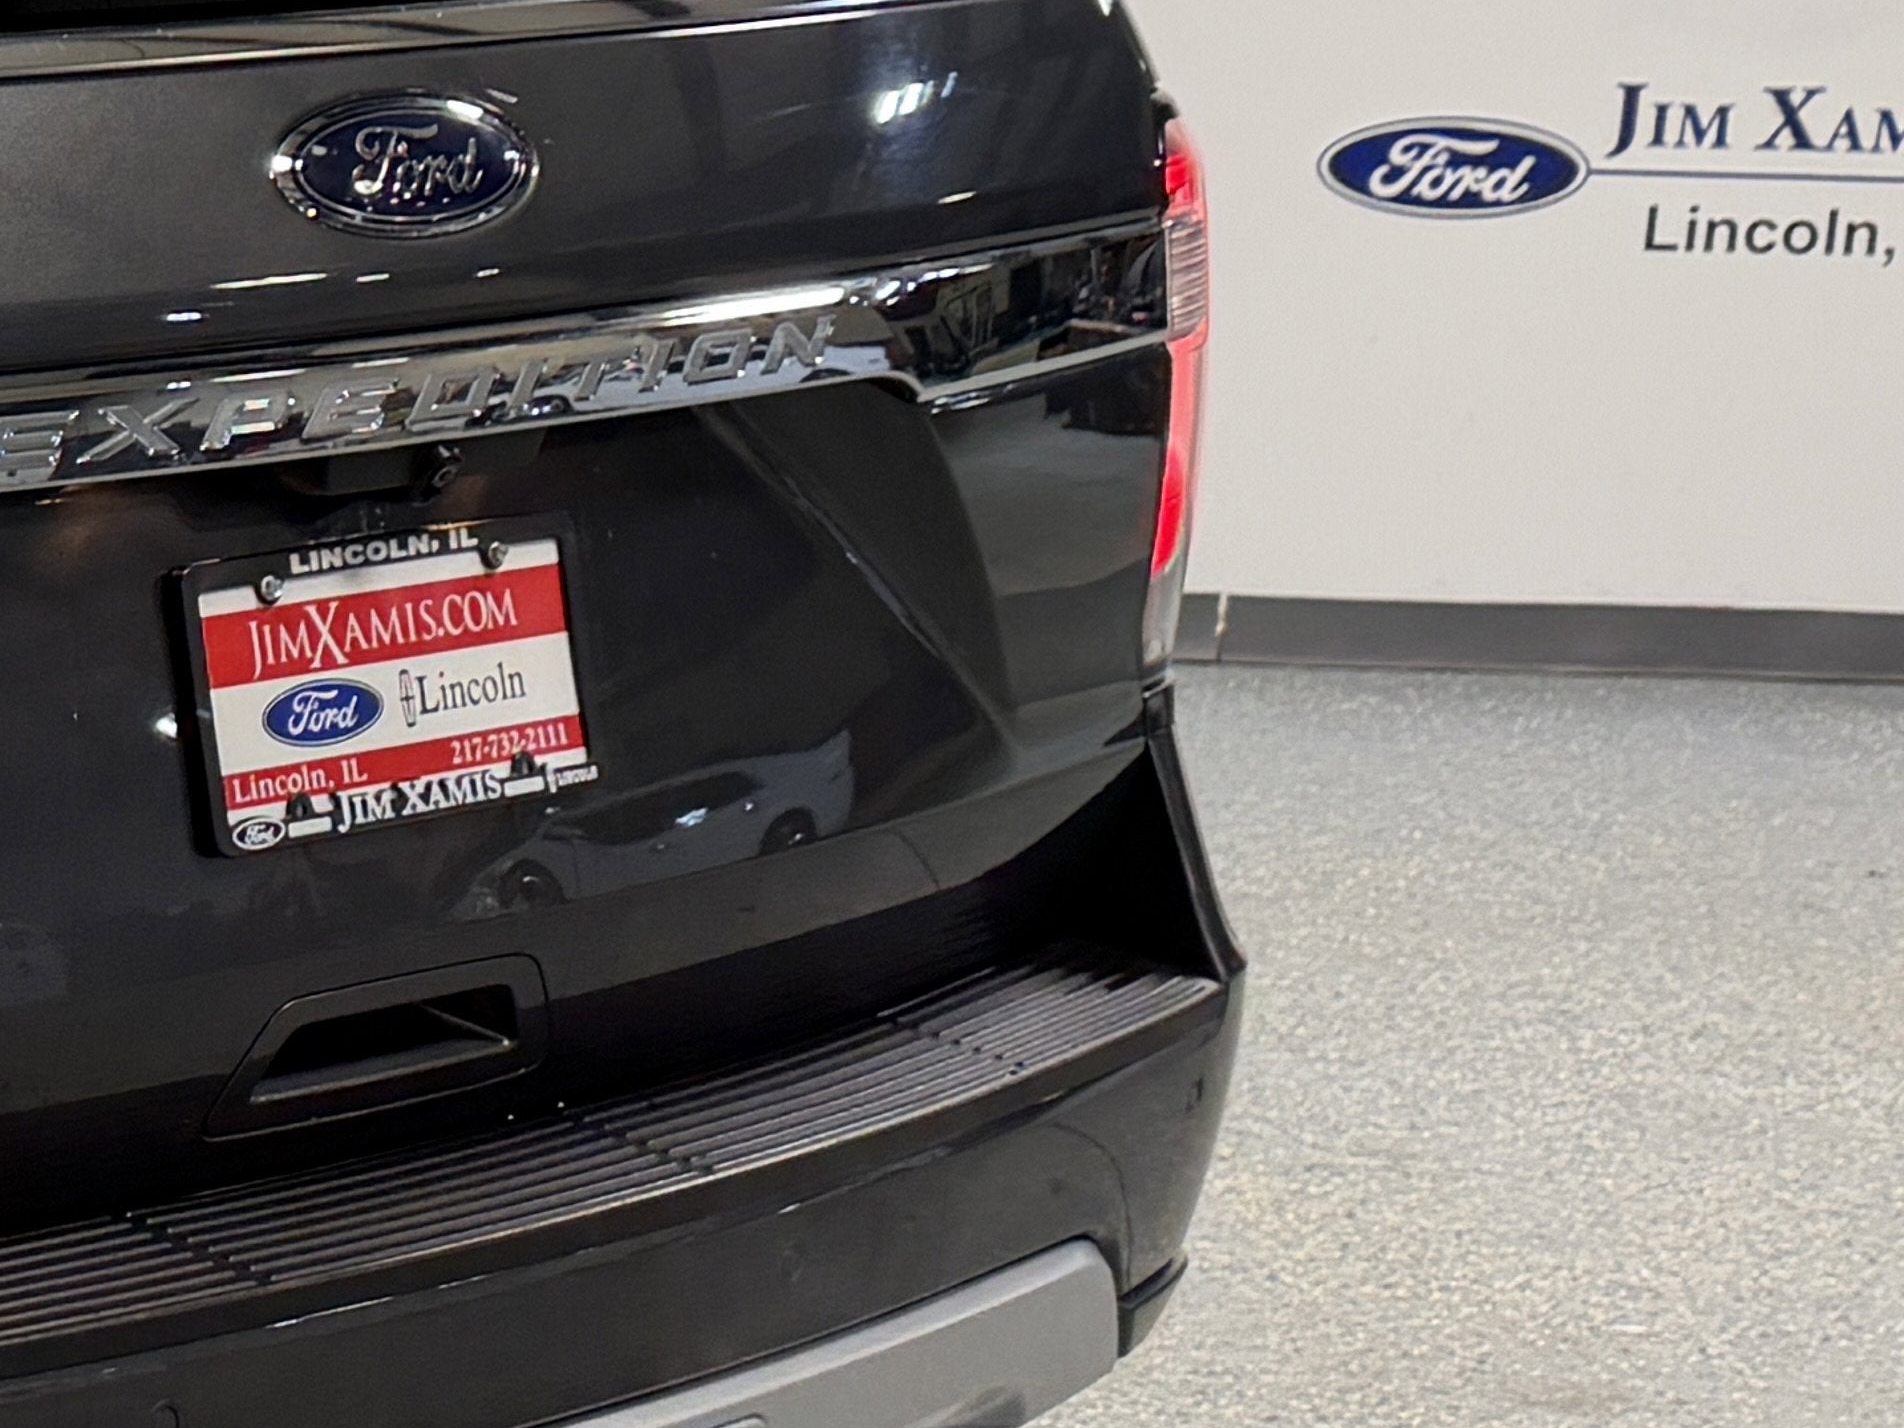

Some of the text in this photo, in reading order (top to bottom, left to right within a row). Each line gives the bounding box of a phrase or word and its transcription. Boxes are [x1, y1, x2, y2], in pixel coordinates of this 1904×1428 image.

[1605, 82, 1737, 159] JIM
[351, 123, 485, 198] Ford
[1368, 133, 1538, 204] Ford
[1642, 204, 1896, 268] Lincoln,
[289, 527, 479, 575] LINCOLN, IL
[248, 588, 519, 680] JIMXAMIS.COM
[287, 688, 360, 738] Ford
[415, 661, 527, 717] Lincoln
[340, 757, 369, 785] IL
[449, 721, 569, 765] 217-732-2111
[335, 786, 398, 835] JIM
[397, 769, 503, 817] XAMIS
